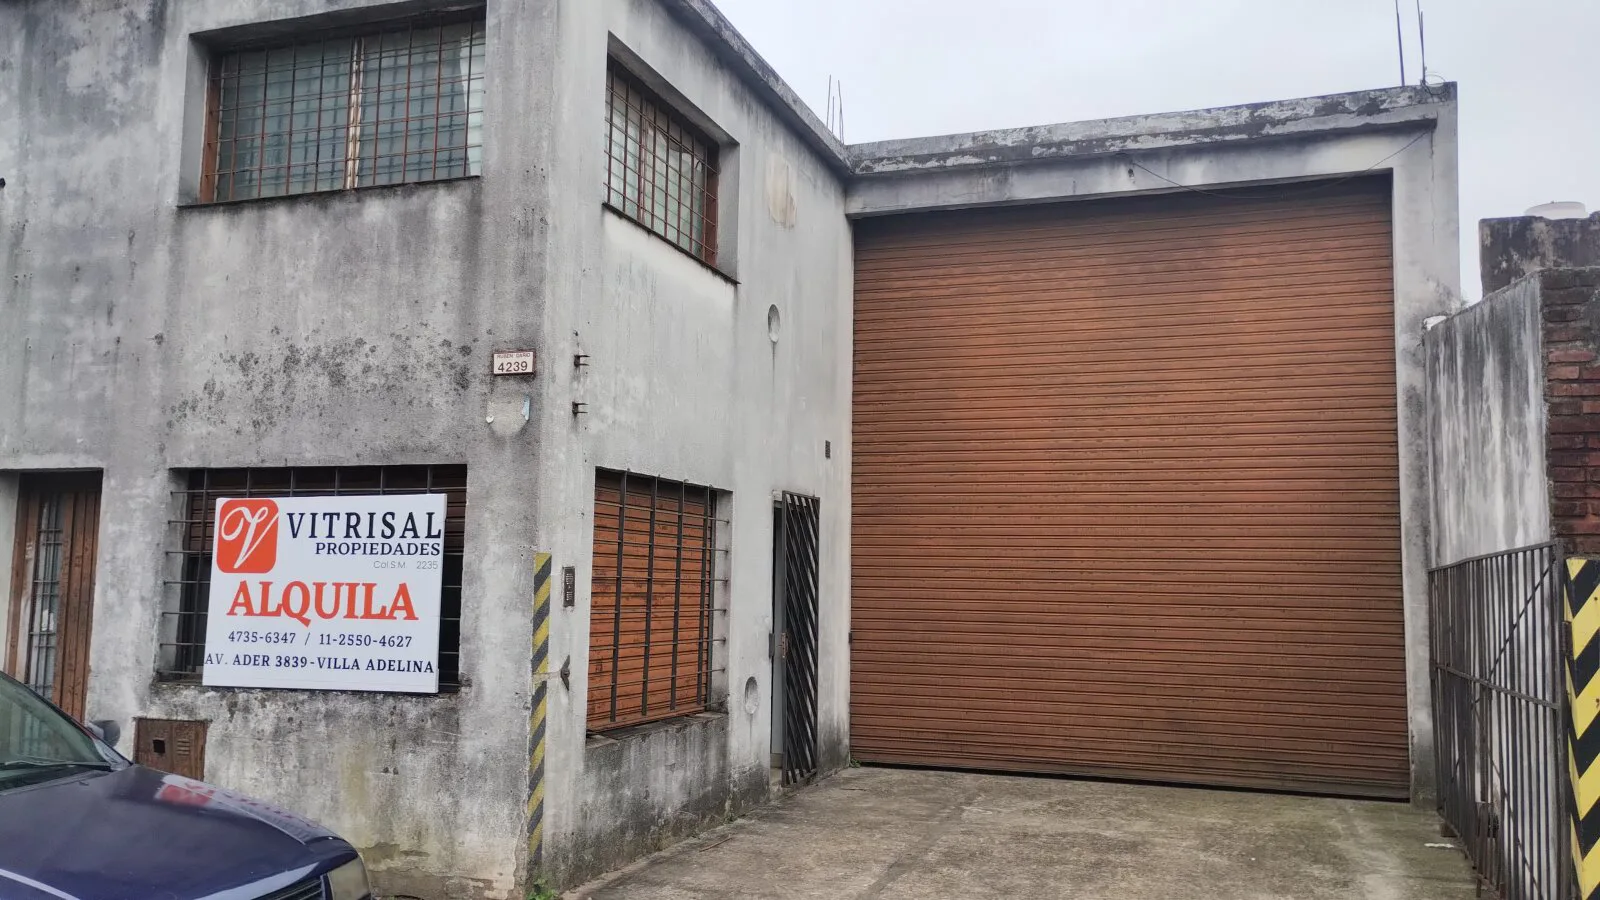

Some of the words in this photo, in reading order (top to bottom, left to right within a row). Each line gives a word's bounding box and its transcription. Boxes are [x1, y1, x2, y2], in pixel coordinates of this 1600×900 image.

[497, 360, 528, 372] 4239
[286, 511, 442, 539] VITRISAL
[315, 542, 441, 556] PROPIEDADES
[416, 560, 439, 570] 2235
[226, 580, 419, 628] ALQUILA
[228, 631, 296, 644] 4735-6347
[319, 633, 412, 647] 11-2550-4627
[204, 653, 228, 665] AV.
[232, 653, 270, 667] ADER
[365, 658, 435, 674] ADELINA
